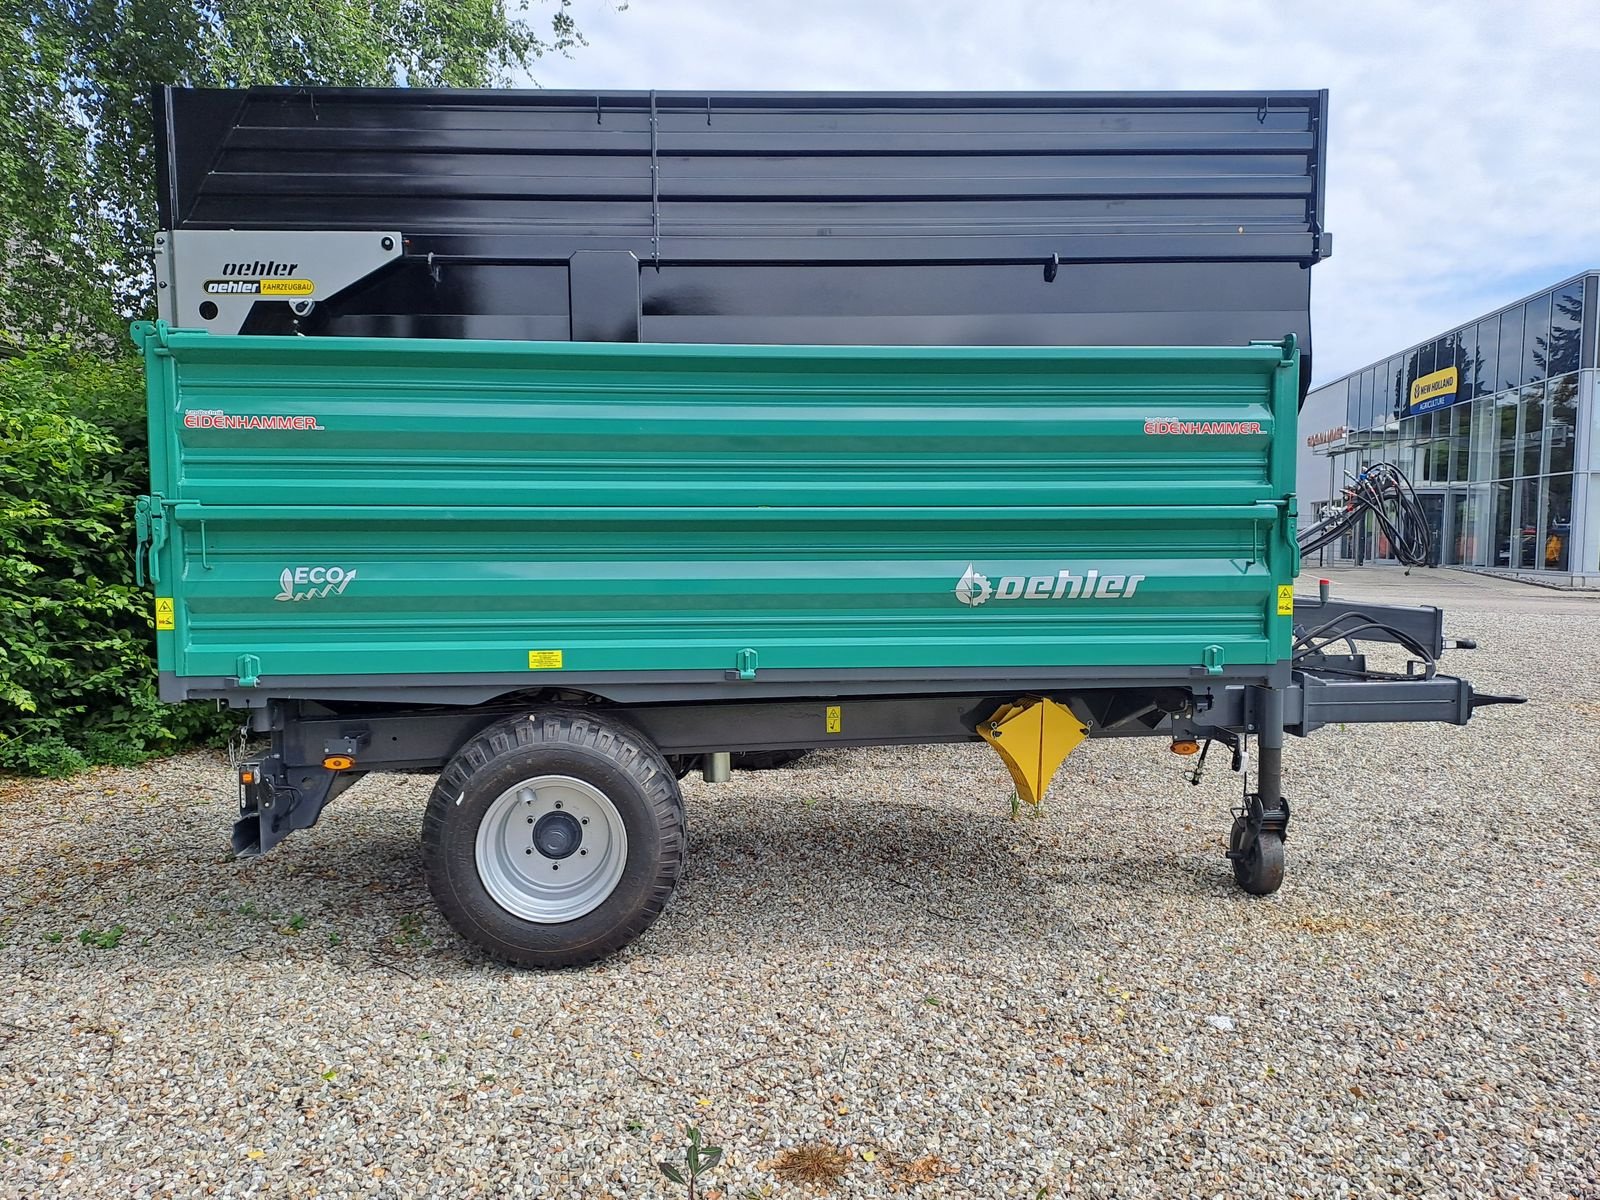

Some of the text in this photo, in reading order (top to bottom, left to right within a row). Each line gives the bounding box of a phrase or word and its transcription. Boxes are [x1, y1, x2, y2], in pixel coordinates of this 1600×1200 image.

[222, 260, 299, 276] oehler
[207, 281, 312, 293] oehler FAHRZEUGBAU
[1420, 376, 1454, 395] NEW HOLLAND
[1419, 397, 1445, 410] AGRICULTURE
[184, 415, 317, 429] EIDENHAMMER
[1144, 422, 1261, 434] EIDENHAMMER
[294, 566, 344, 584] ECO
[994, 569, 1146, 599] oehler
